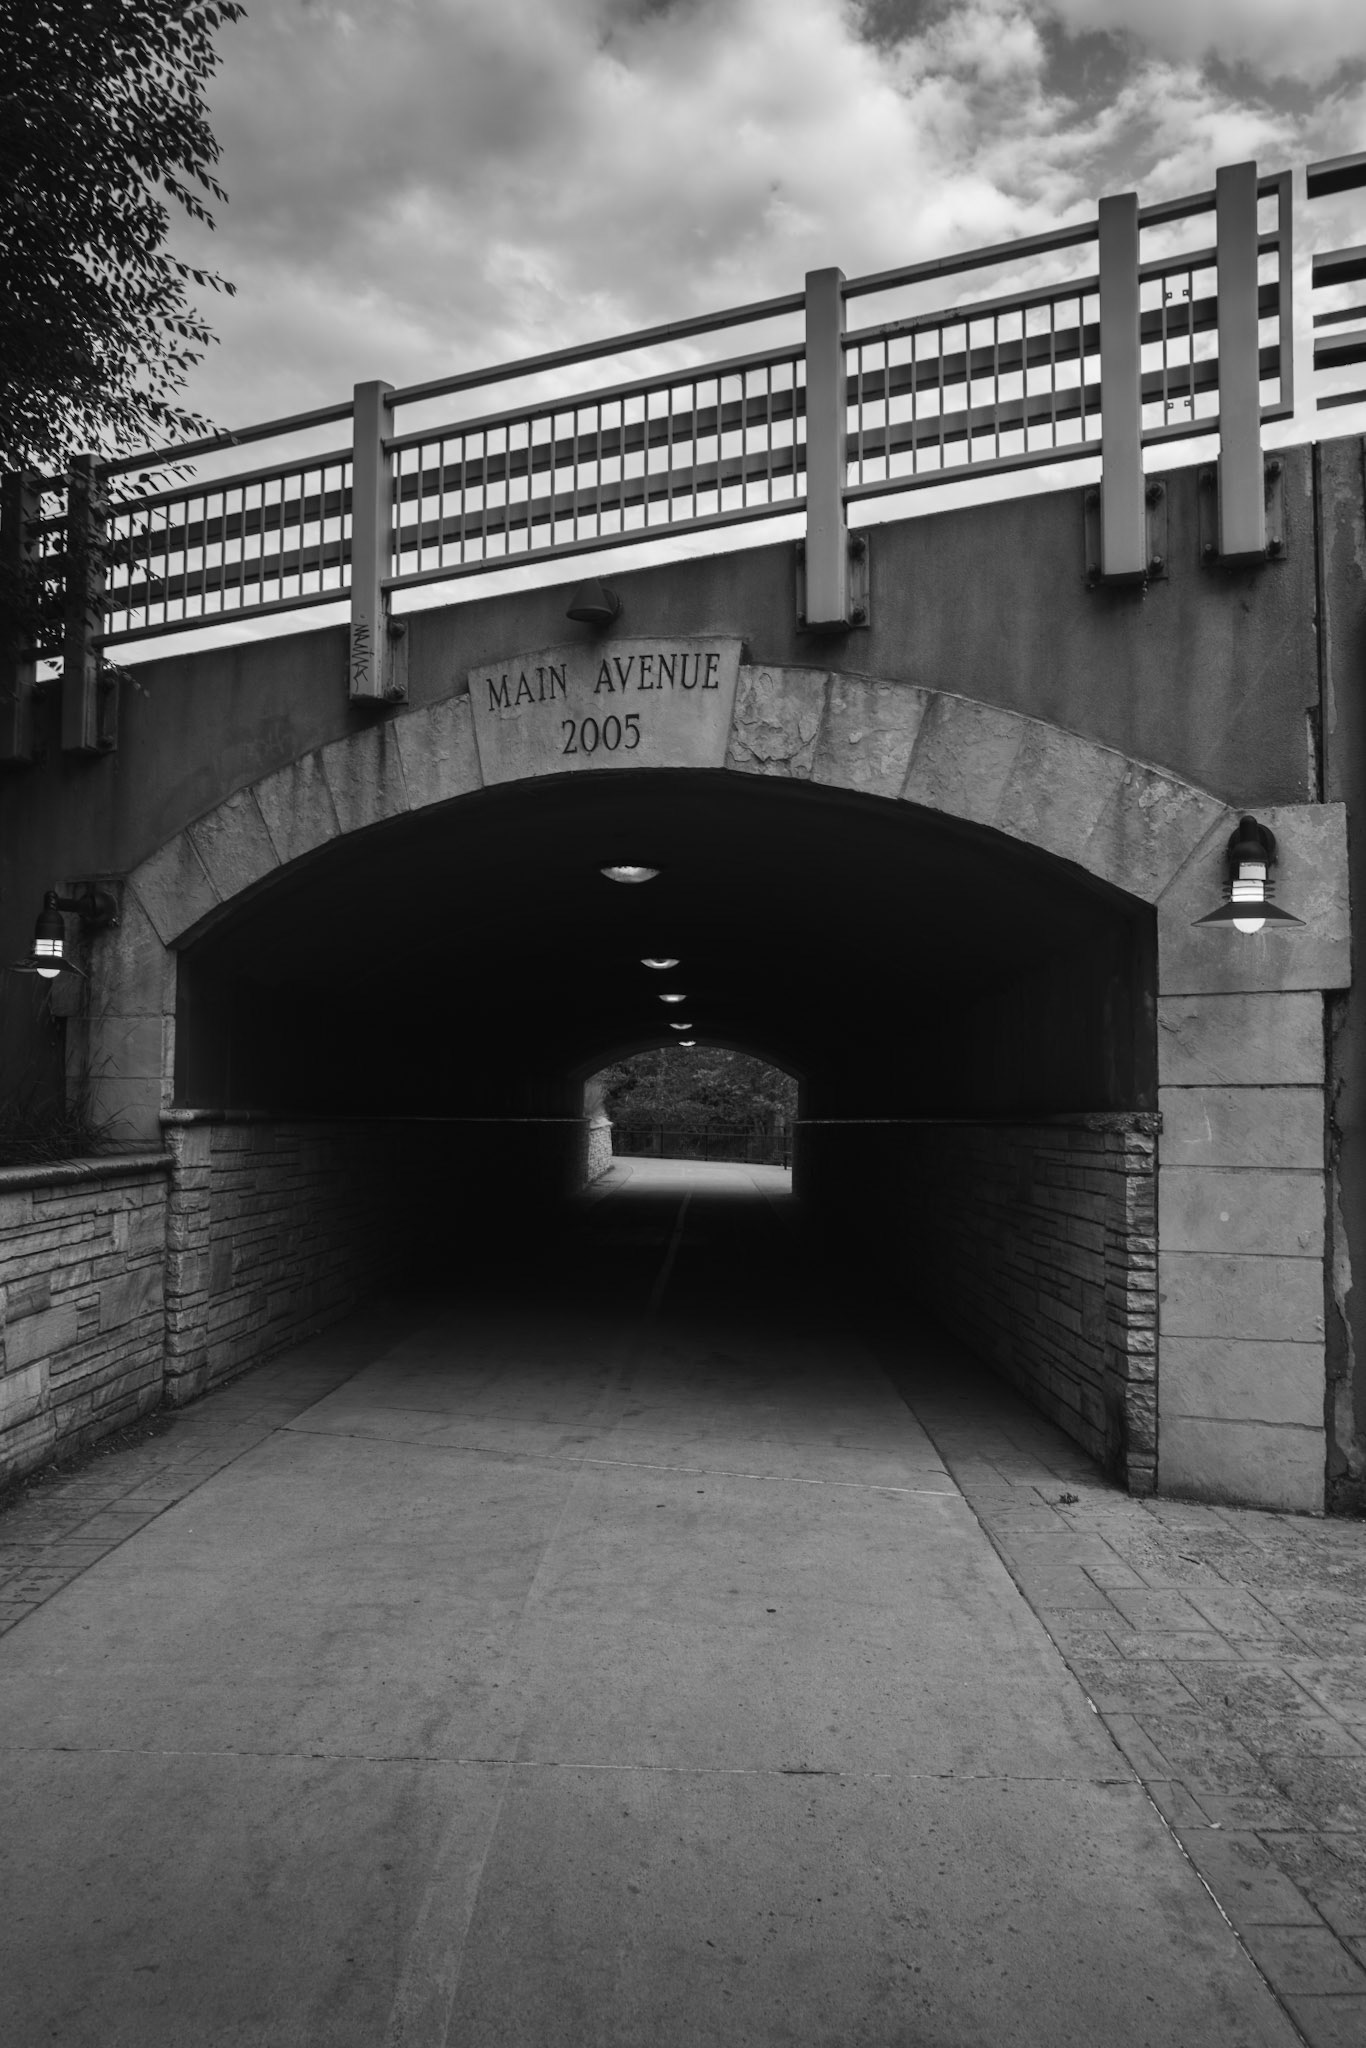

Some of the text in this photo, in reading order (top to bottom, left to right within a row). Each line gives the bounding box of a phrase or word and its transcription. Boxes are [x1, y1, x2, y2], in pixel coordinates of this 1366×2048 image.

[486, 653, 720, 711] MAIN AVENUE
[561, 713, 641, 754] 2005
